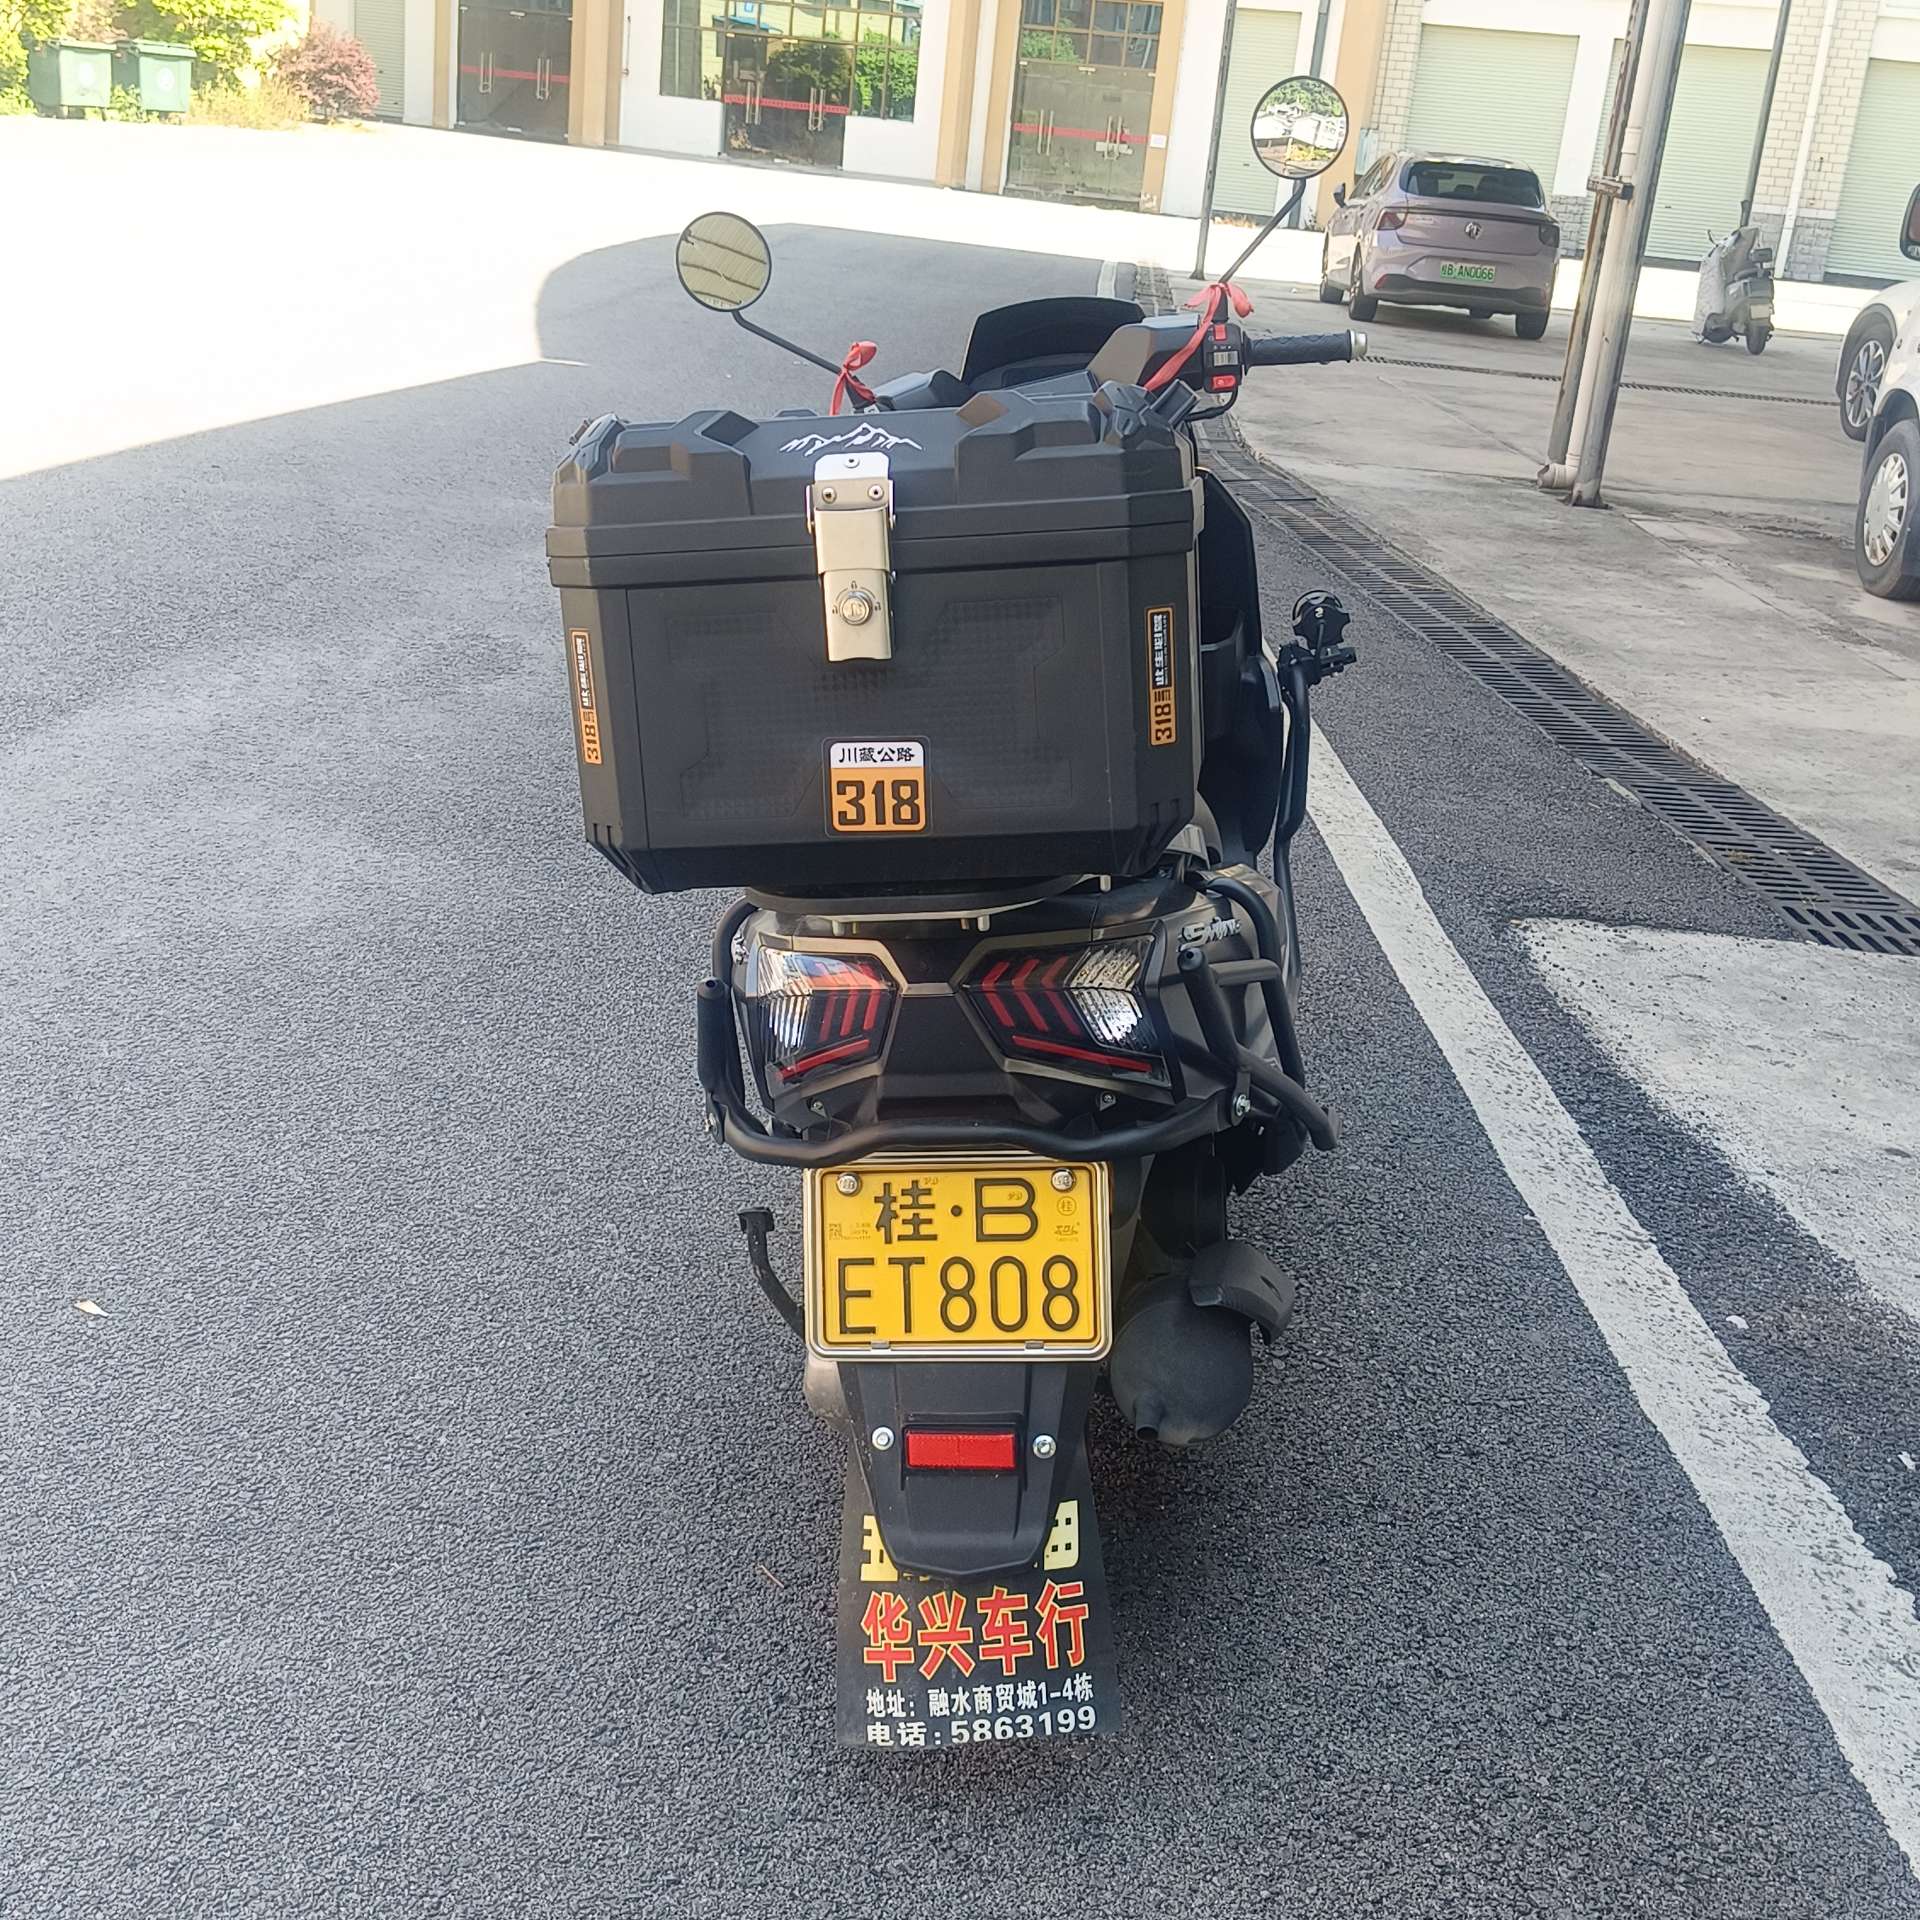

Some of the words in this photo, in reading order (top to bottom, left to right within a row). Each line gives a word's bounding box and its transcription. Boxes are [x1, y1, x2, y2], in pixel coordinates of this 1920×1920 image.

[584, 724, 599, 760] 318
[1155, 703, 1172, 741] 318
[839, 747, 915, 763] 川藏公路
[837, 779, 920, 826] 318
[874, 1177, 1038, 1244] 桂·B
[838, 1254, 1080, 1335] ET808
[861, 1579, 1089, 1683] 华兴车行
